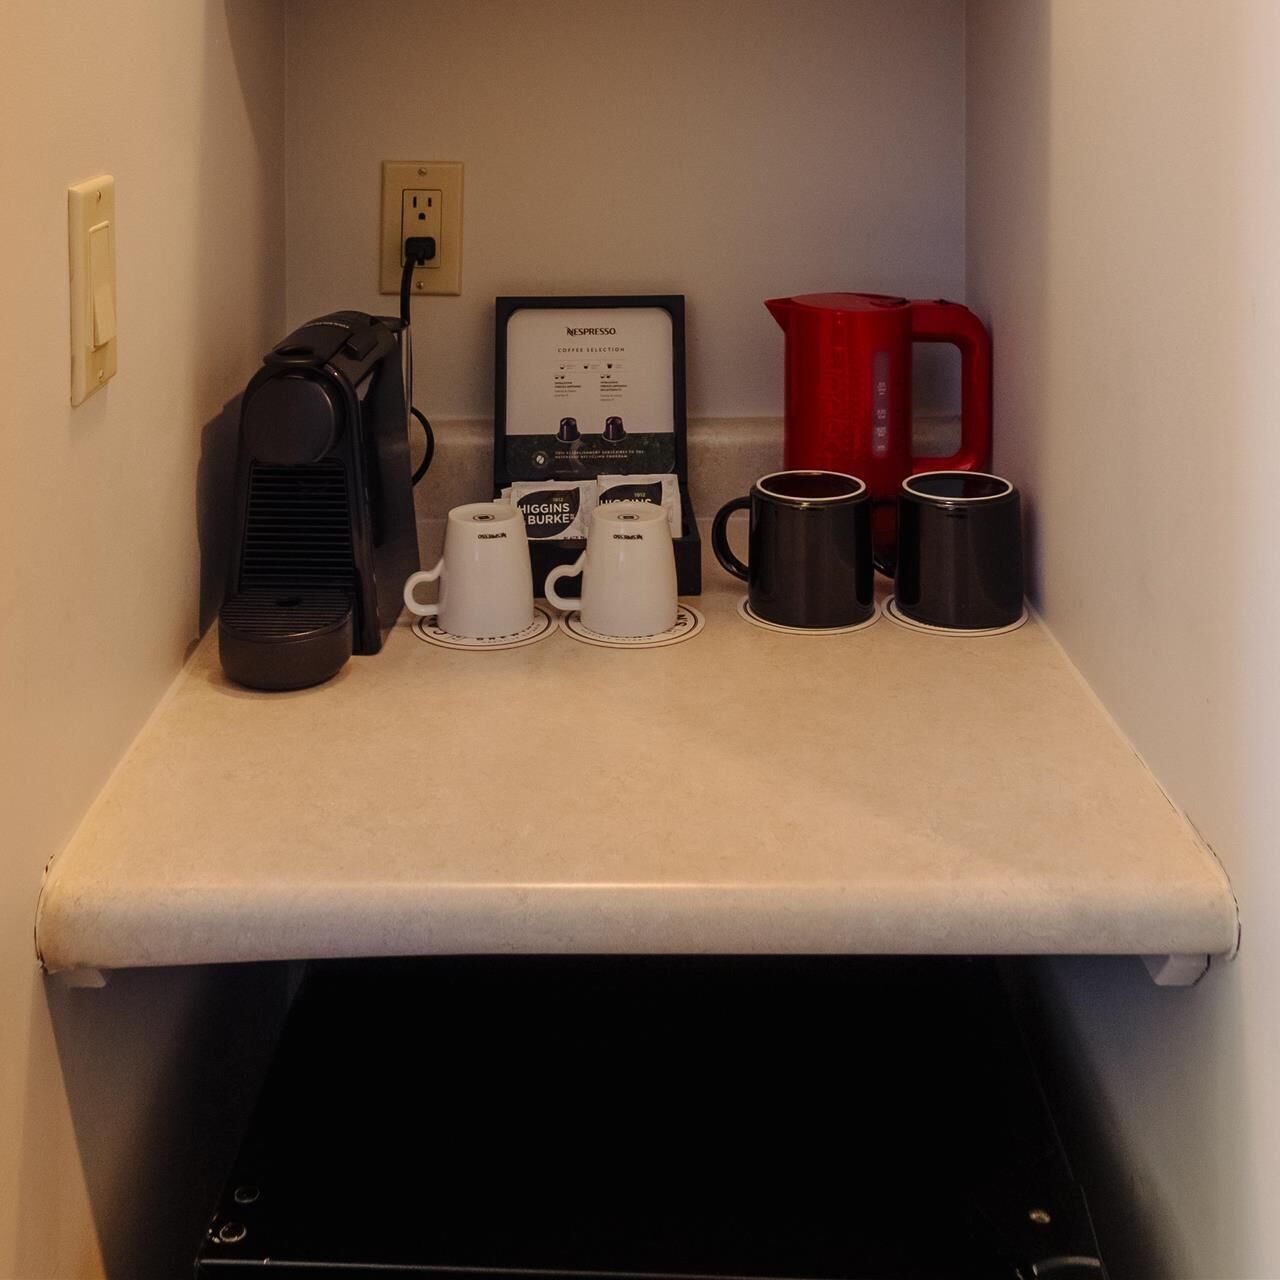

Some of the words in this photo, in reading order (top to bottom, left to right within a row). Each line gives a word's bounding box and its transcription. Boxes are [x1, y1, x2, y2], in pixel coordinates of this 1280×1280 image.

[566, 327, 616, 336] NESPRESSO
[519, 503, 569, 514] HIGGINS
[528, 514, 570, 525] BURKE
